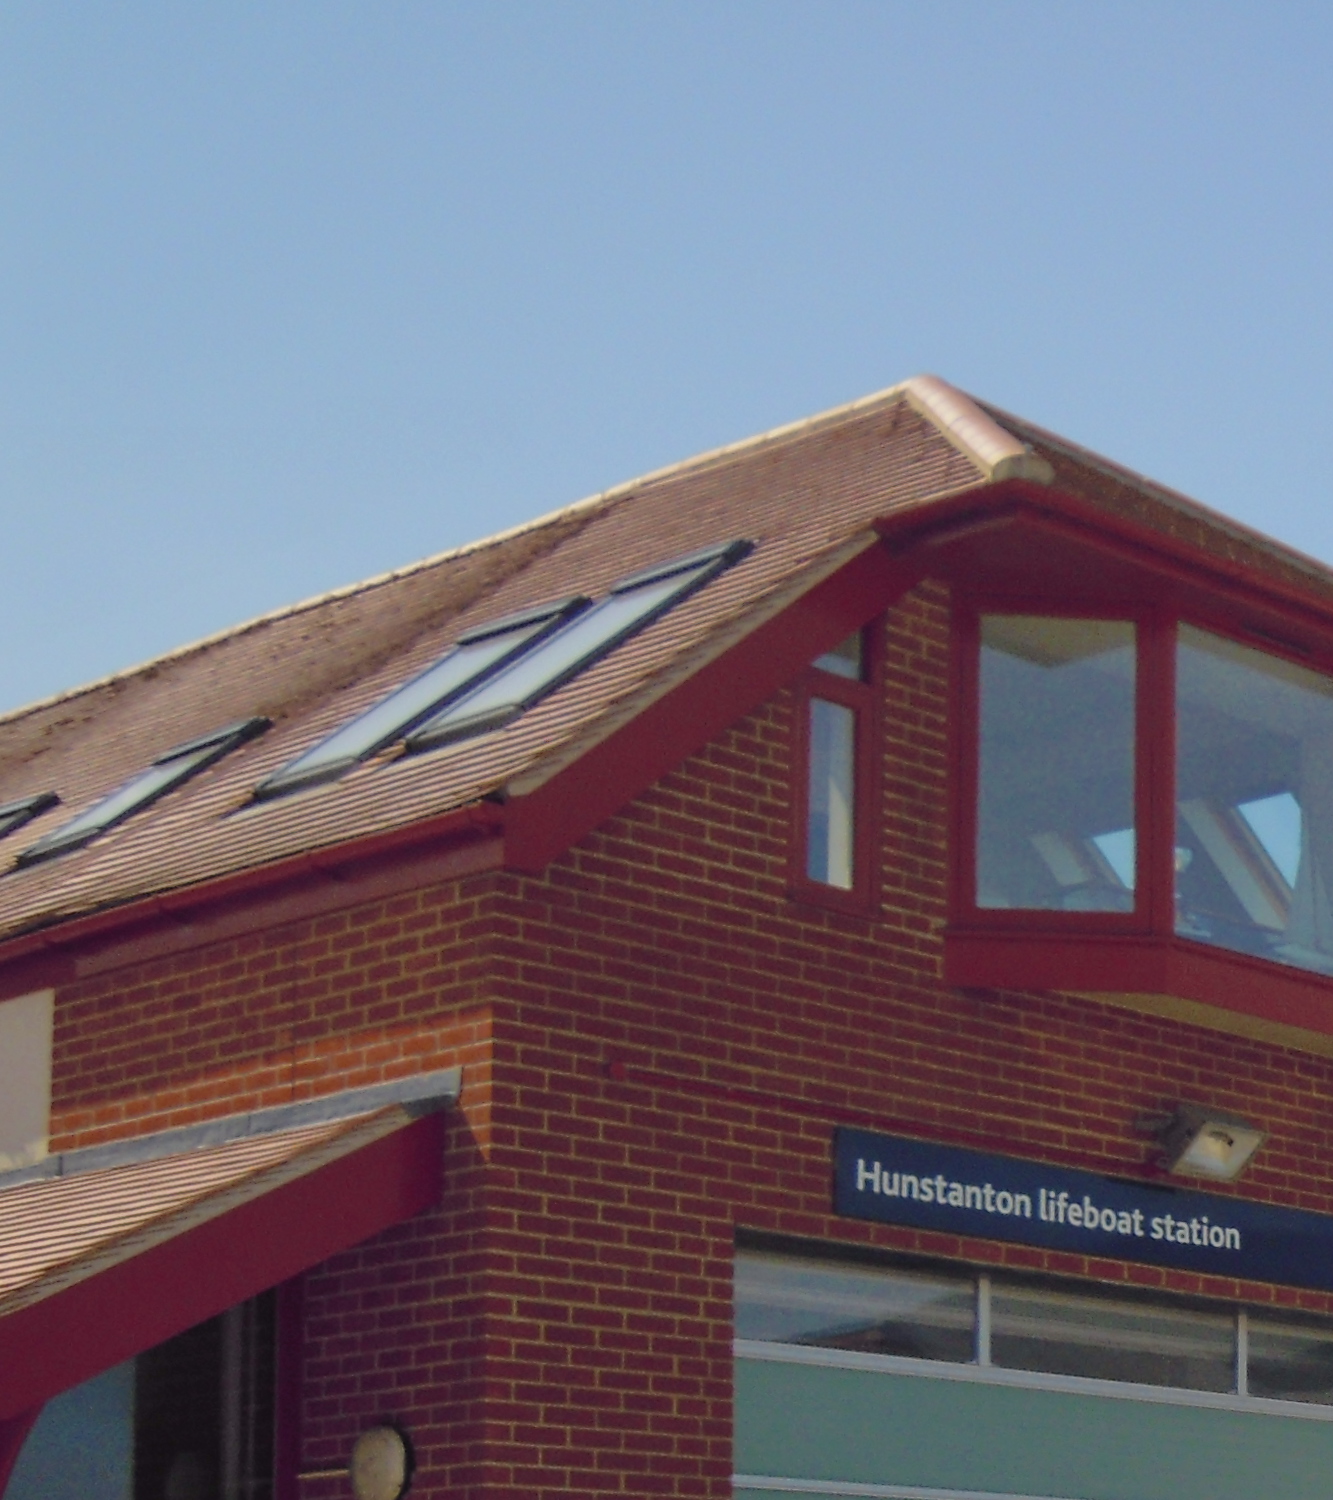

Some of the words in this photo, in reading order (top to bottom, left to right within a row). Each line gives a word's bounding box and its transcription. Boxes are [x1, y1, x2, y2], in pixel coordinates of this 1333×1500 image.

[856, 1158, 1032, 1218] Hunstanton
[1039, 1188, 1144, 1237] lifeboat
[1151, 1214, 1241, 1250] station
